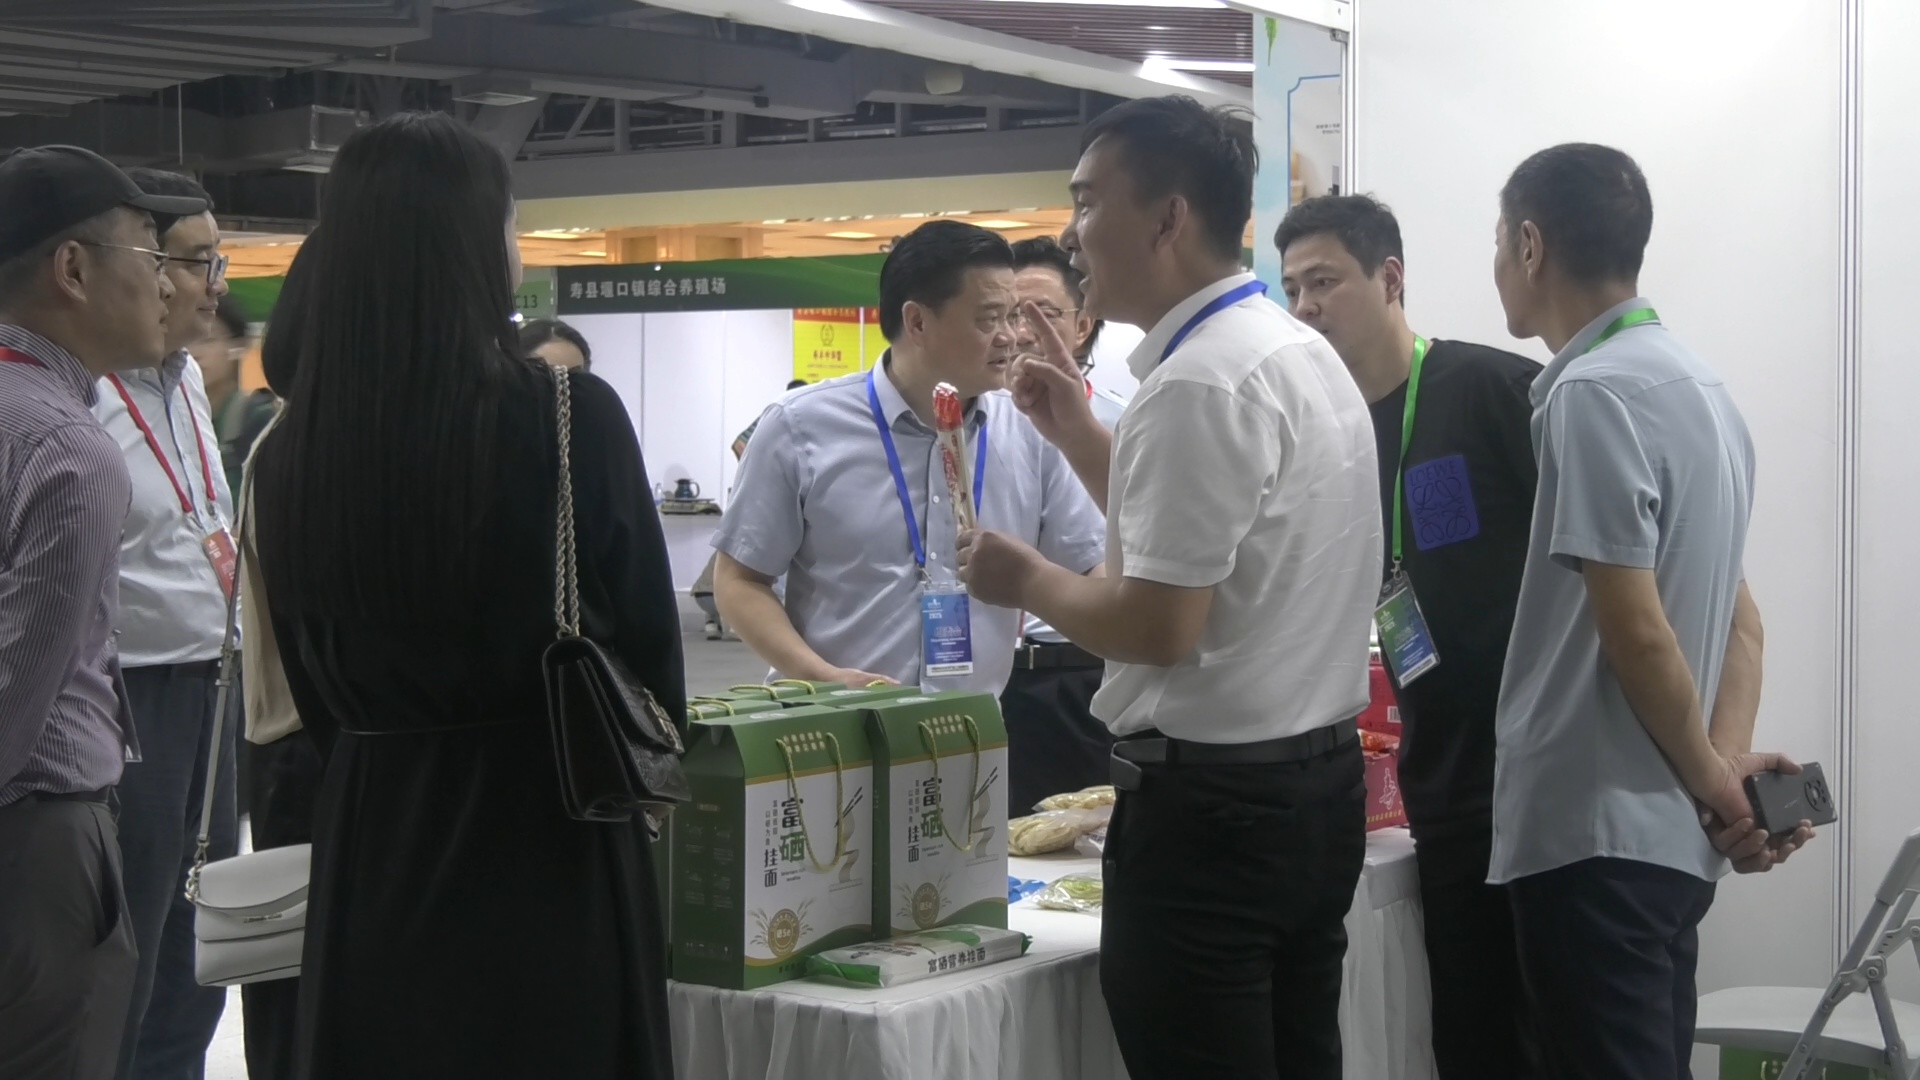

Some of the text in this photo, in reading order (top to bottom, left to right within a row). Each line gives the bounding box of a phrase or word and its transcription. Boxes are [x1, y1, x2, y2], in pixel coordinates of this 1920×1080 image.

[569, 277, 726, 299] 寿县堰口镇综合养殖场
[1409, 460, 1458, 486] LOEWE
[764, 848, 778, 887] 挂面
[927, 947, 986, 973] 富硒营养挂面
